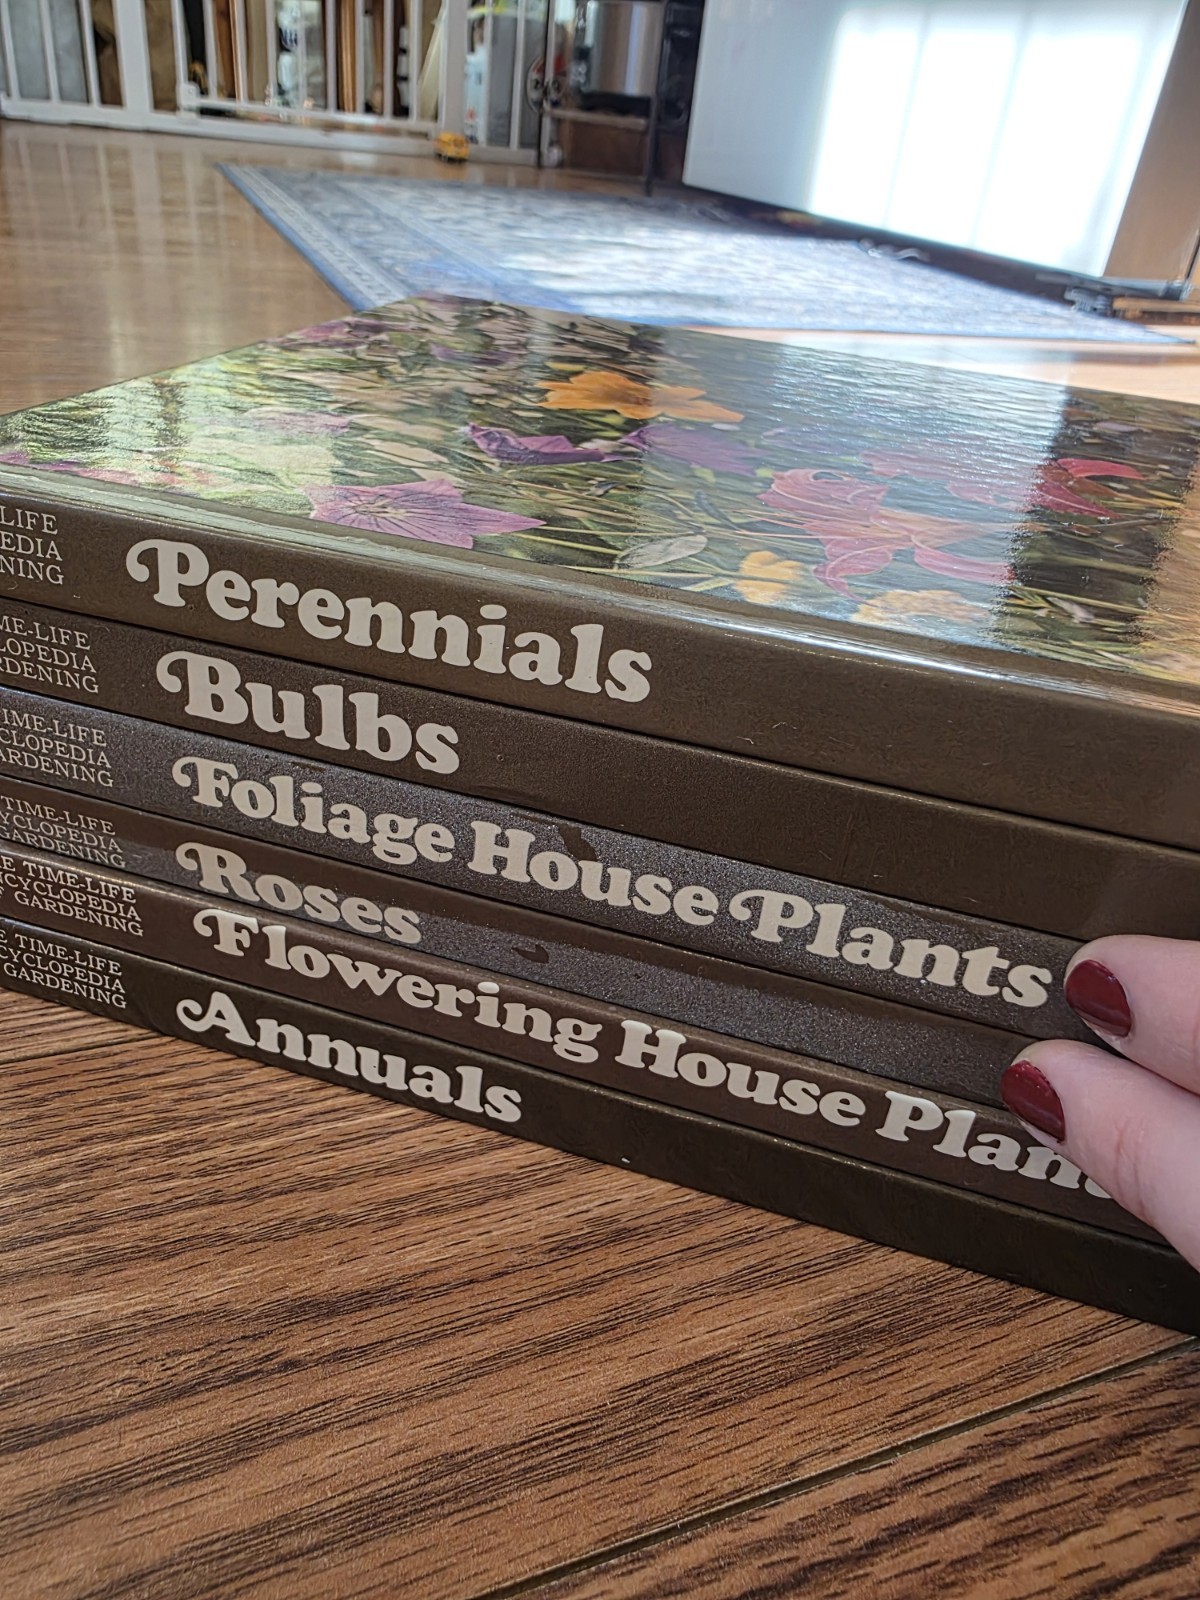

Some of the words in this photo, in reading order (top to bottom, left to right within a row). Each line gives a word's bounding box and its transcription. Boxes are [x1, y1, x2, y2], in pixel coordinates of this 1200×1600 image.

[126, 539, 652, 702] Perennials
[0, 638, 97, 673] OPEDIA
[0, 656, 99, 694] DENING
[156, 651, 460, 774] Bulbs
[1, 796, 116, 835] TIME-LIFE
[0, 826, 126, 868] GARDENING
[0, 872, 142, 922] CYCLOPEDIA
[23, 861, 136, 904] TIME-LIFE
[172, 757, 455, 865] Foliage
[467, 821, 719, 925] House
[729, 889, 1052, 1007] Plants
[176, 842, 421, 944] Roses
[14, 891, 144, 937] GARDENING
[15, 933, 122, 976] TIME-LIFE
[4, 962, 127, 1009] GARDENING
[193, 909, 602, 1063] Flowering
[615, 1020, 866, 1127] House
[176, 991, 522, 1122] Annuals
